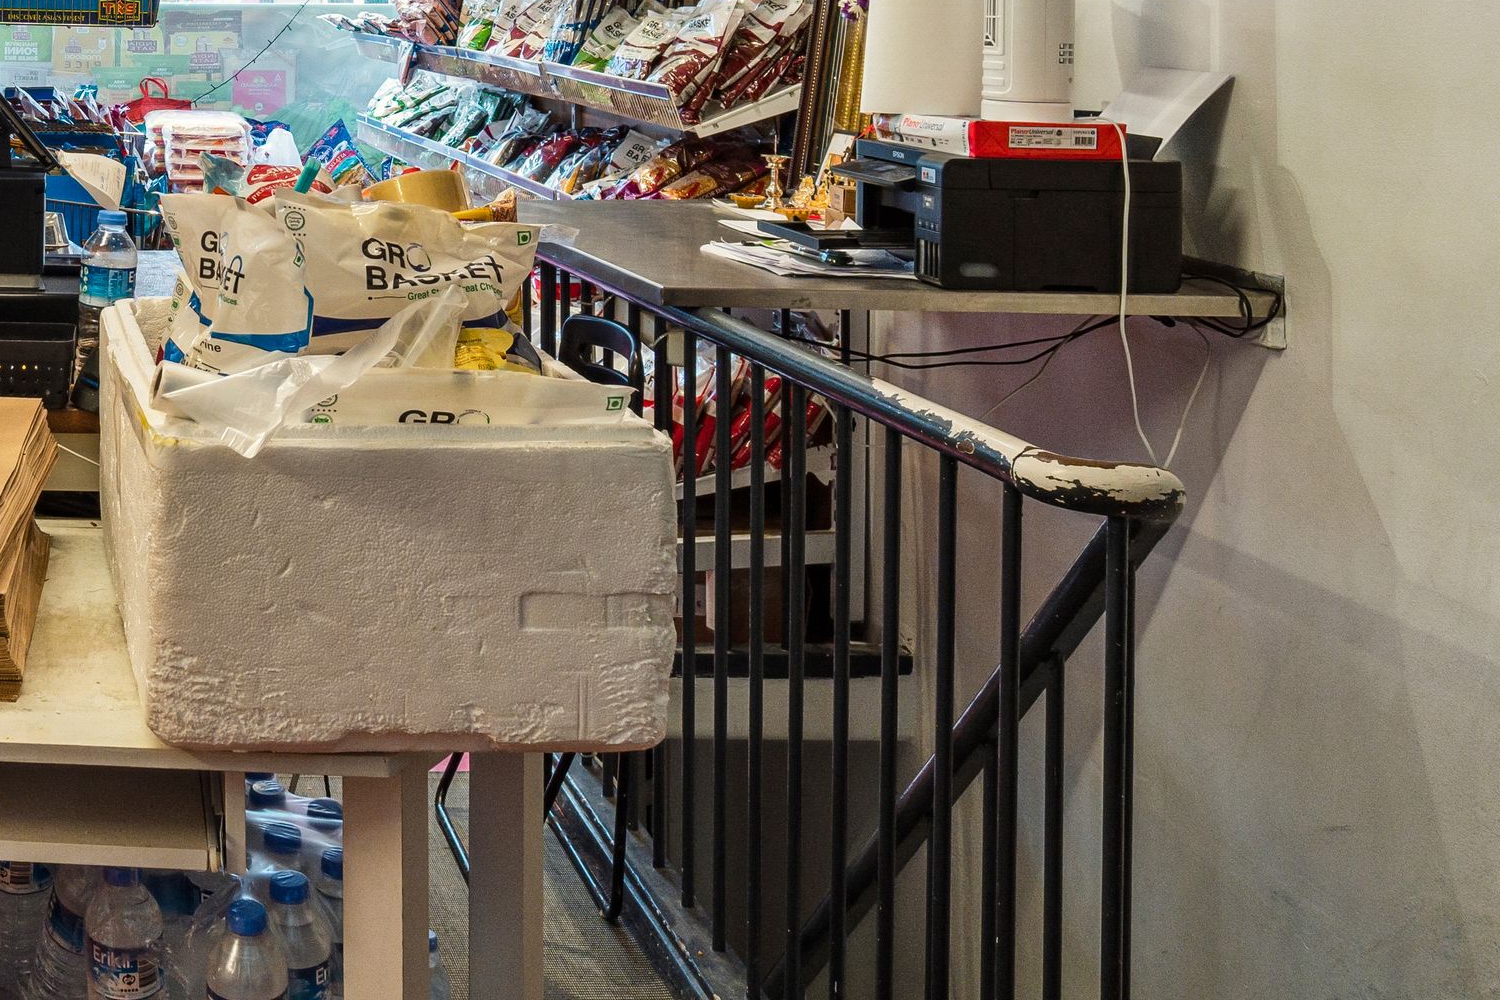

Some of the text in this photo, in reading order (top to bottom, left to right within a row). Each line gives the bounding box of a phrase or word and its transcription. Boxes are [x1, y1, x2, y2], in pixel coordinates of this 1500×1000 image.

[102, 2, 137, 16] TRS
[7, 13, 40, 22] DISCOVER
[64, 15, 86, 23] FINEST
[902, 117, 946, 132] Plano Universal
[892, 150, 905, 160] EPSON
[407, 290, 430, 301] Great
